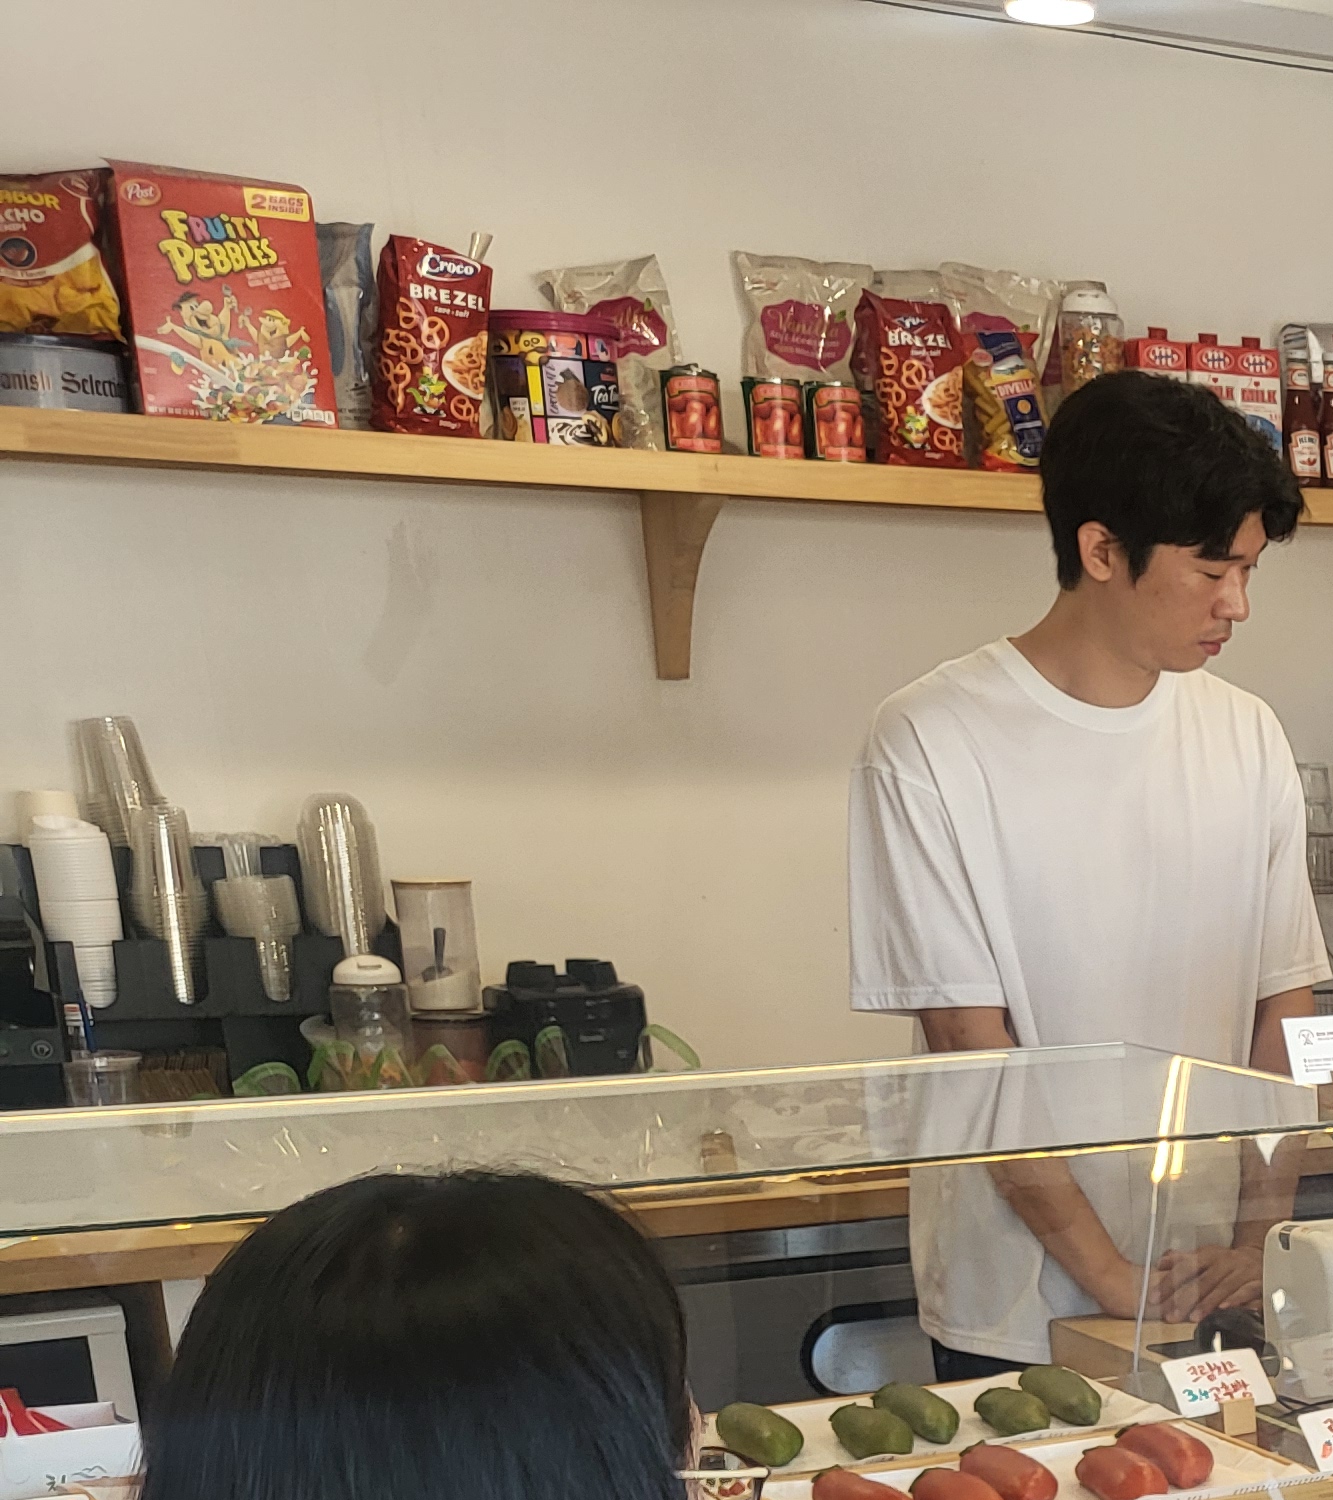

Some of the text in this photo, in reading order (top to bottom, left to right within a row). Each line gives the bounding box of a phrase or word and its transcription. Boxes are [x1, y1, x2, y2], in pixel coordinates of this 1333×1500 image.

[126, 184, 155, 198] Post
[251, 194, 266, 210] 2
[159, 238, 278, 284] PEBBLES
[421, 253, 475, 277] Croco
[410, 283, 486, 312] BREZEL
[0, 370, 53, 391] anish
[999, 381, 1036, 397] DIVELLA
[1242, 388, 1277, 404] MILK
